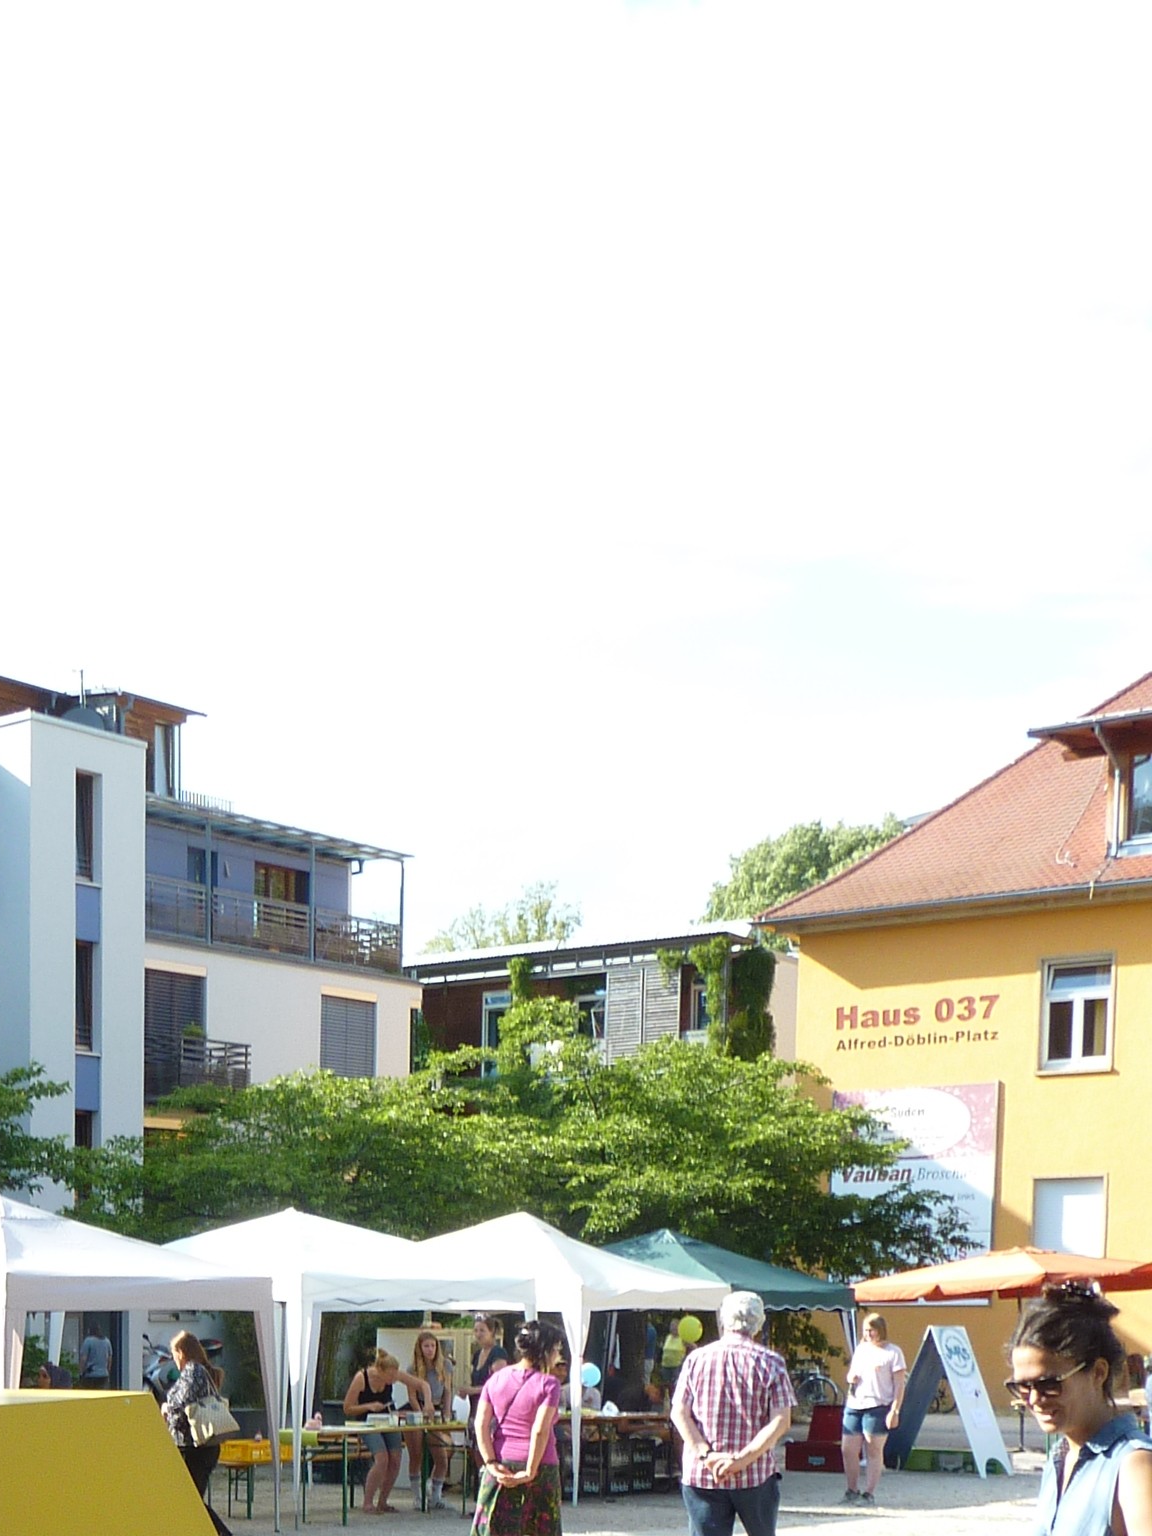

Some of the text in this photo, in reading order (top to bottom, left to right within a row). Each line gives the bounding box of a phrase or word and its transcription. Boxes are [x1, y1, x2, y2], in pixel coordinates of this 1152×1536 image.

[836, 994, 1000, 1031] Haus 037
[836, 1029, 999, 1051] Alfred-Döblin-Platz
[842, 1166, 912, 1184] Vauban
